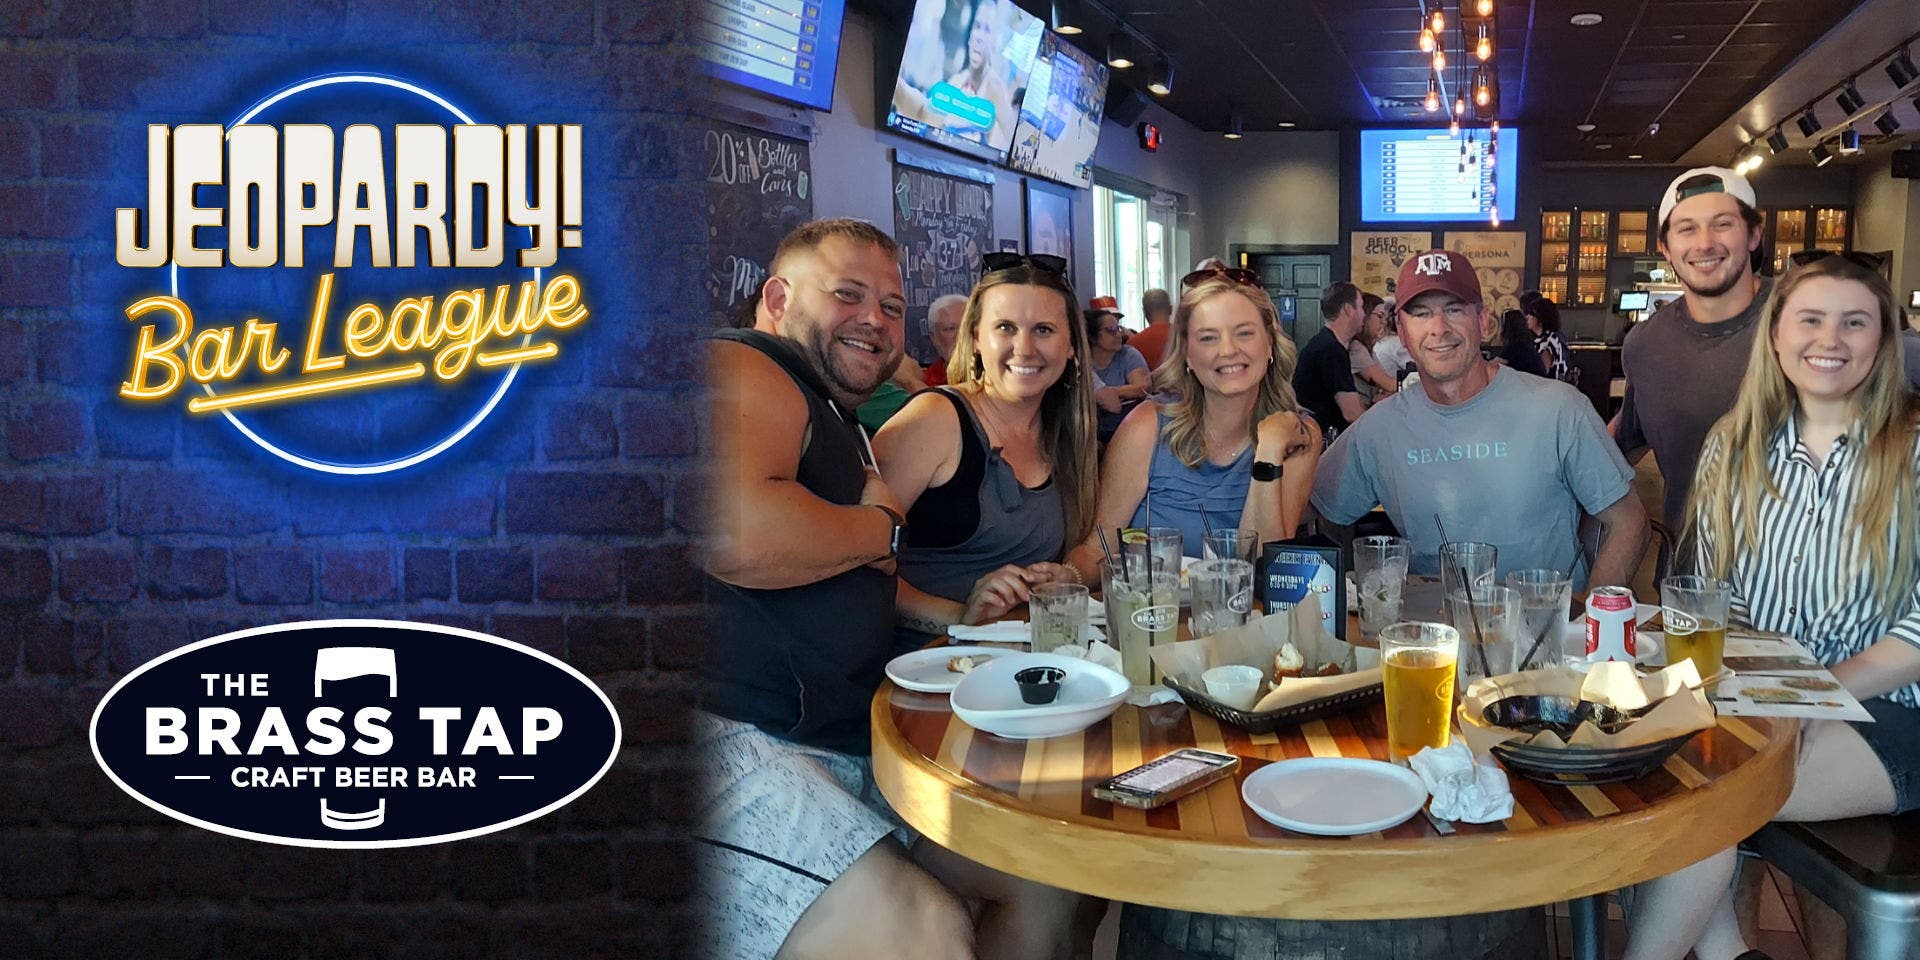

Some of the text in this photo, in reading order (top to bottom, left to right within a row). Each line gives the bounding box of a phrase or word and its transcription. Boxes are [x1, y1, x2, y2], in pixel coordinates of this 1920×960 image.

[758, 138, 801, 171] Bottles
[760, 171, 792, 196] Cans
[1365, 244, 1414, 255] SCHOOL
[1368, 237, 1398, 247] BEER
[1407, 441, 1508, 465] SEASIDE
